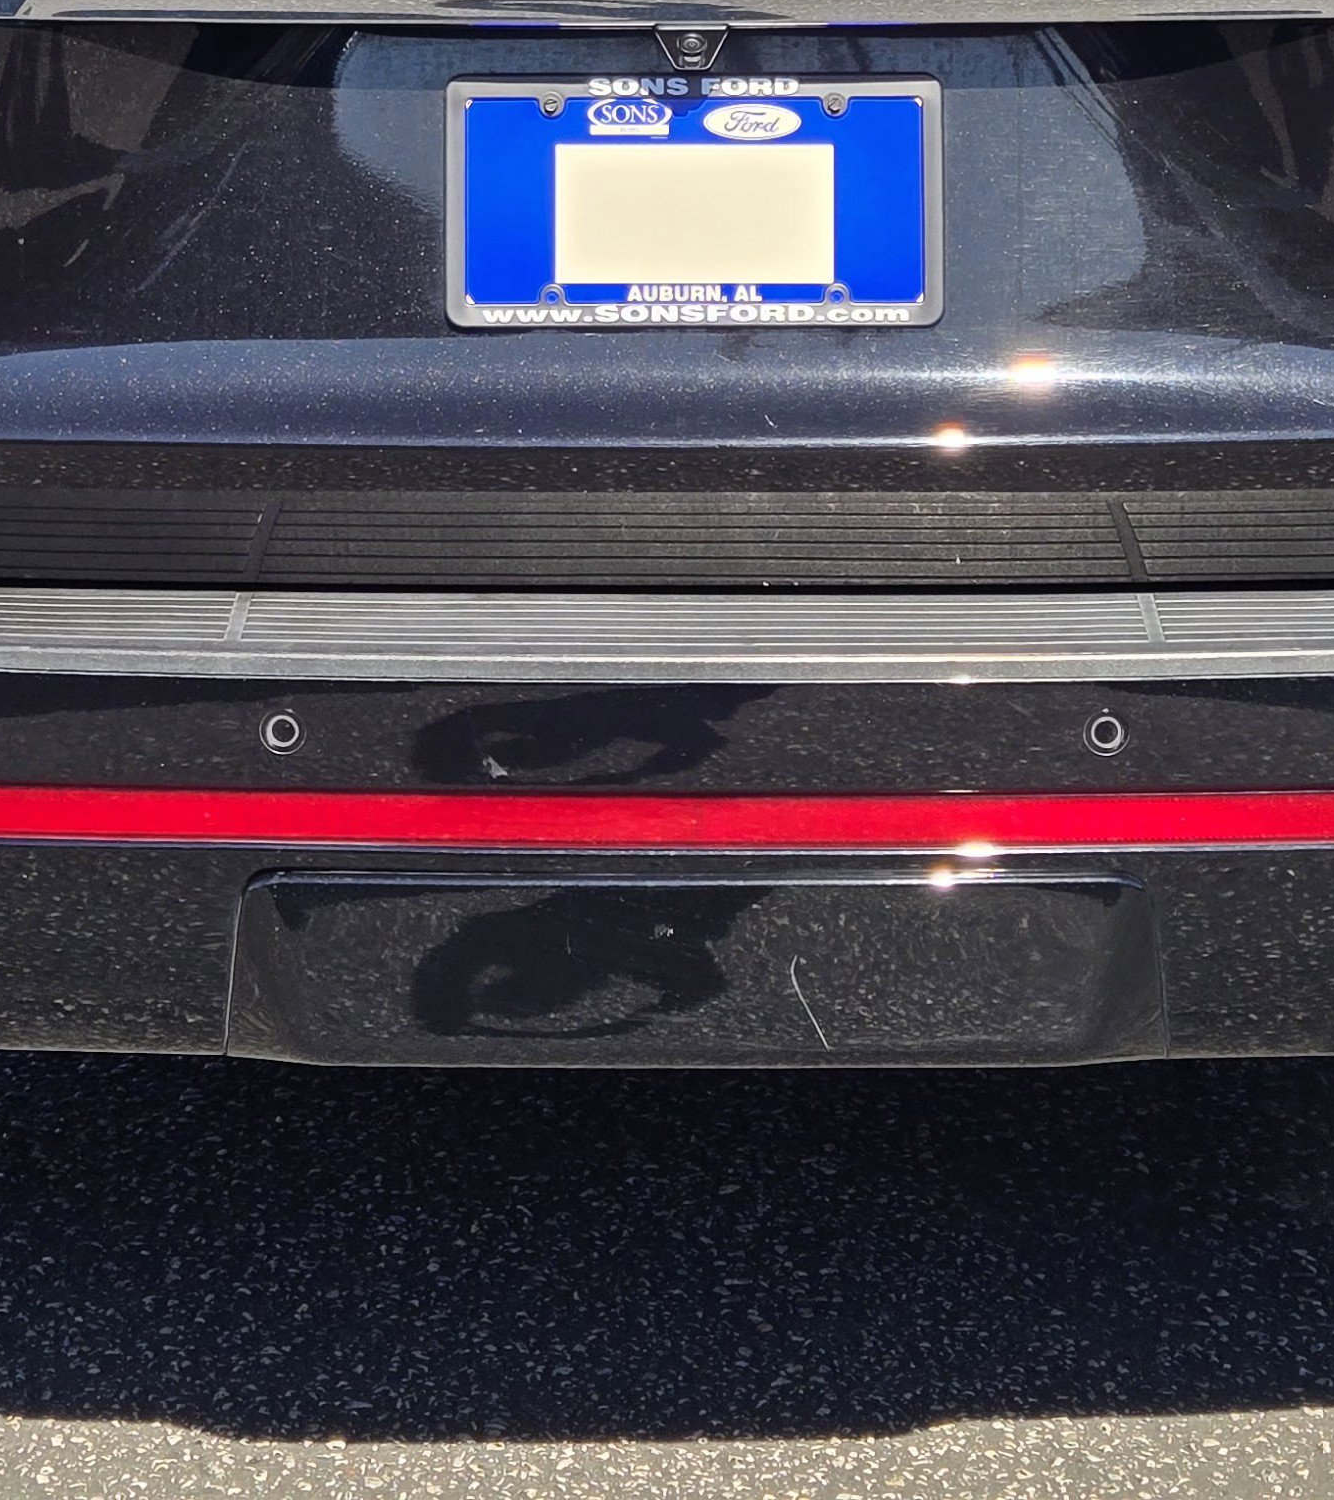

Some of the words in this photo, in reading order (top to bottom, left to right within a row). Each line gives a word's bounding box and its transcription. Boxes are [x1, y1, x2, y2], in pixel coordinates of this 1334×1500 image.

[588, 77, 689, 97] SONS
[701, 77, 800, 97] FORD
[600, 103, 660, 124] SONS
[723, 110, 781, 134] Ford
[734, 285, 763, 303] AL
[482, 304, 911, 324] www.SONSFORD.com
